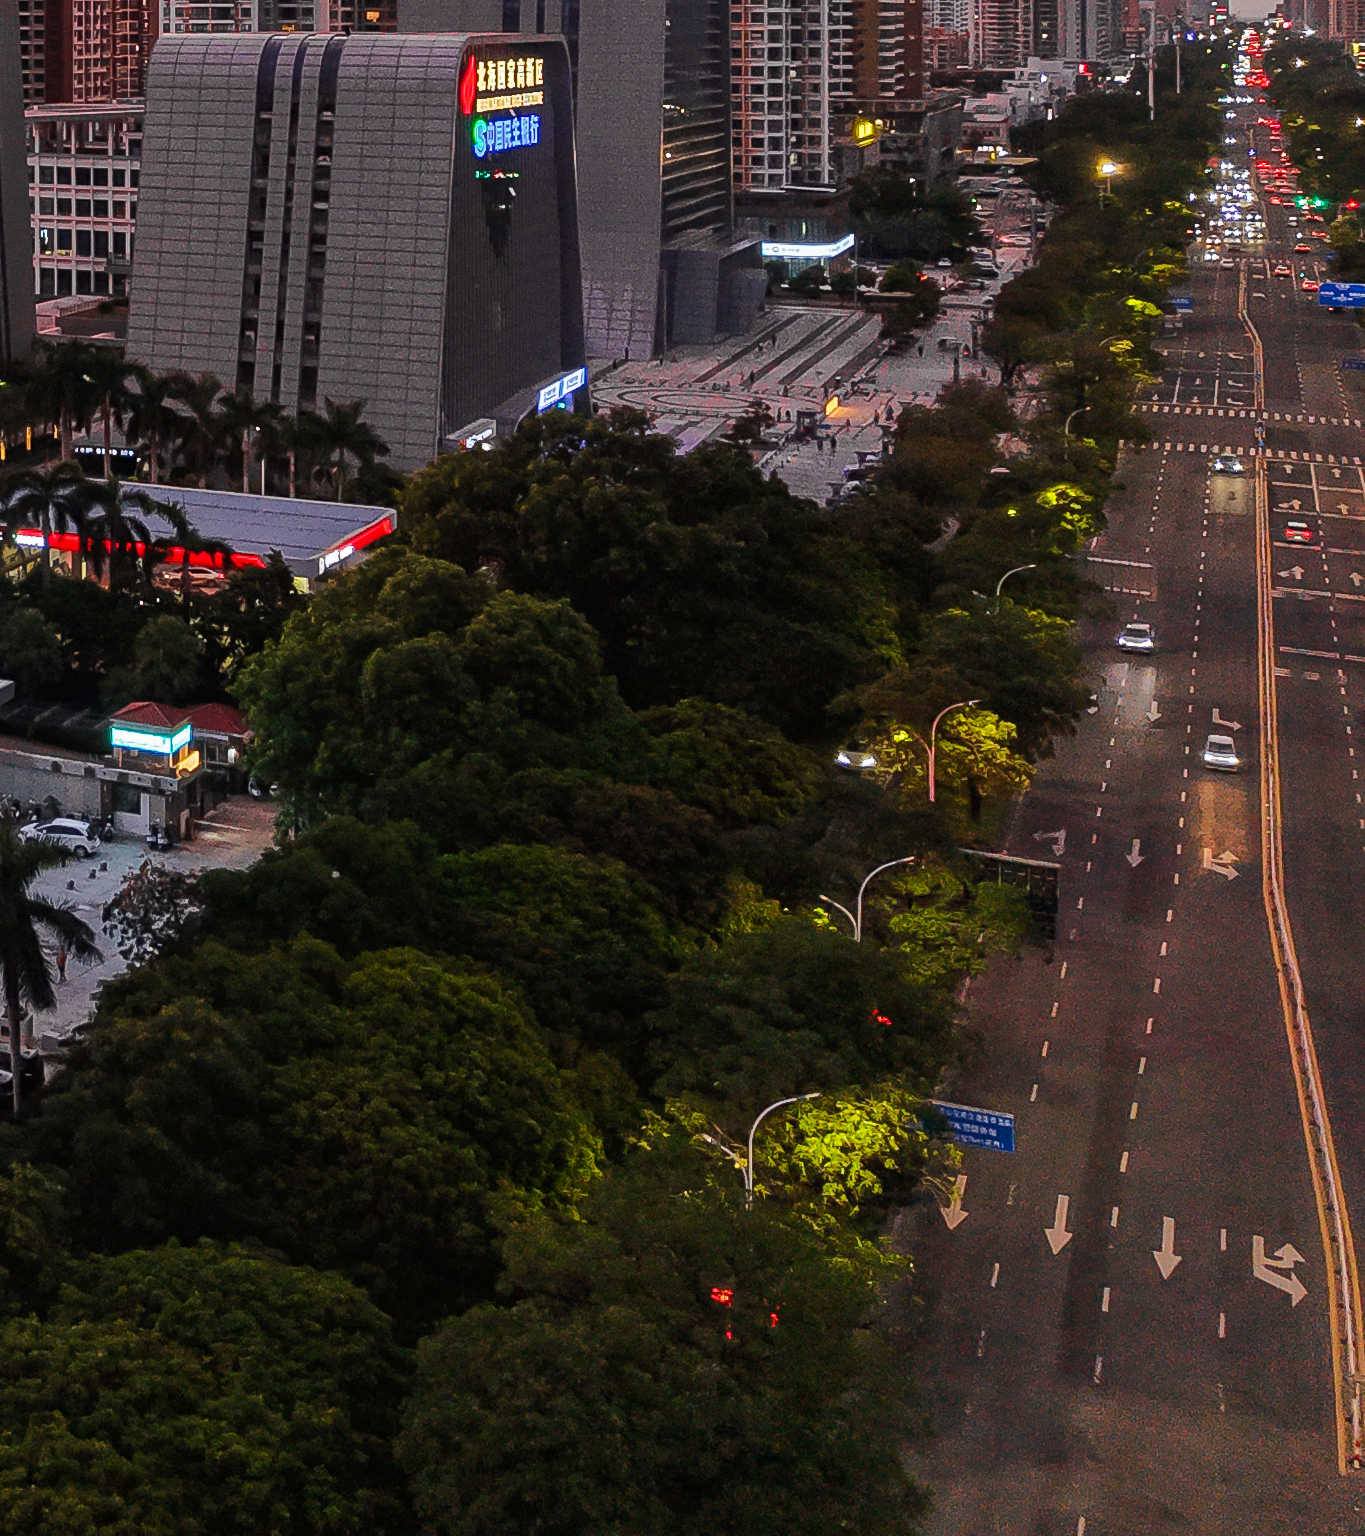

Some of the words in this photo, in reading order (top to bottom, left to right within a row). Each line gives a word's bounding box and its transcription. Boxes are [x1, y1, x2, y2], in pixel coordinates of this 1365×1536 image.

[476, 57, 544, 91] 北海国家高新区
[486, 114, 540, 152] 中国民生银行
